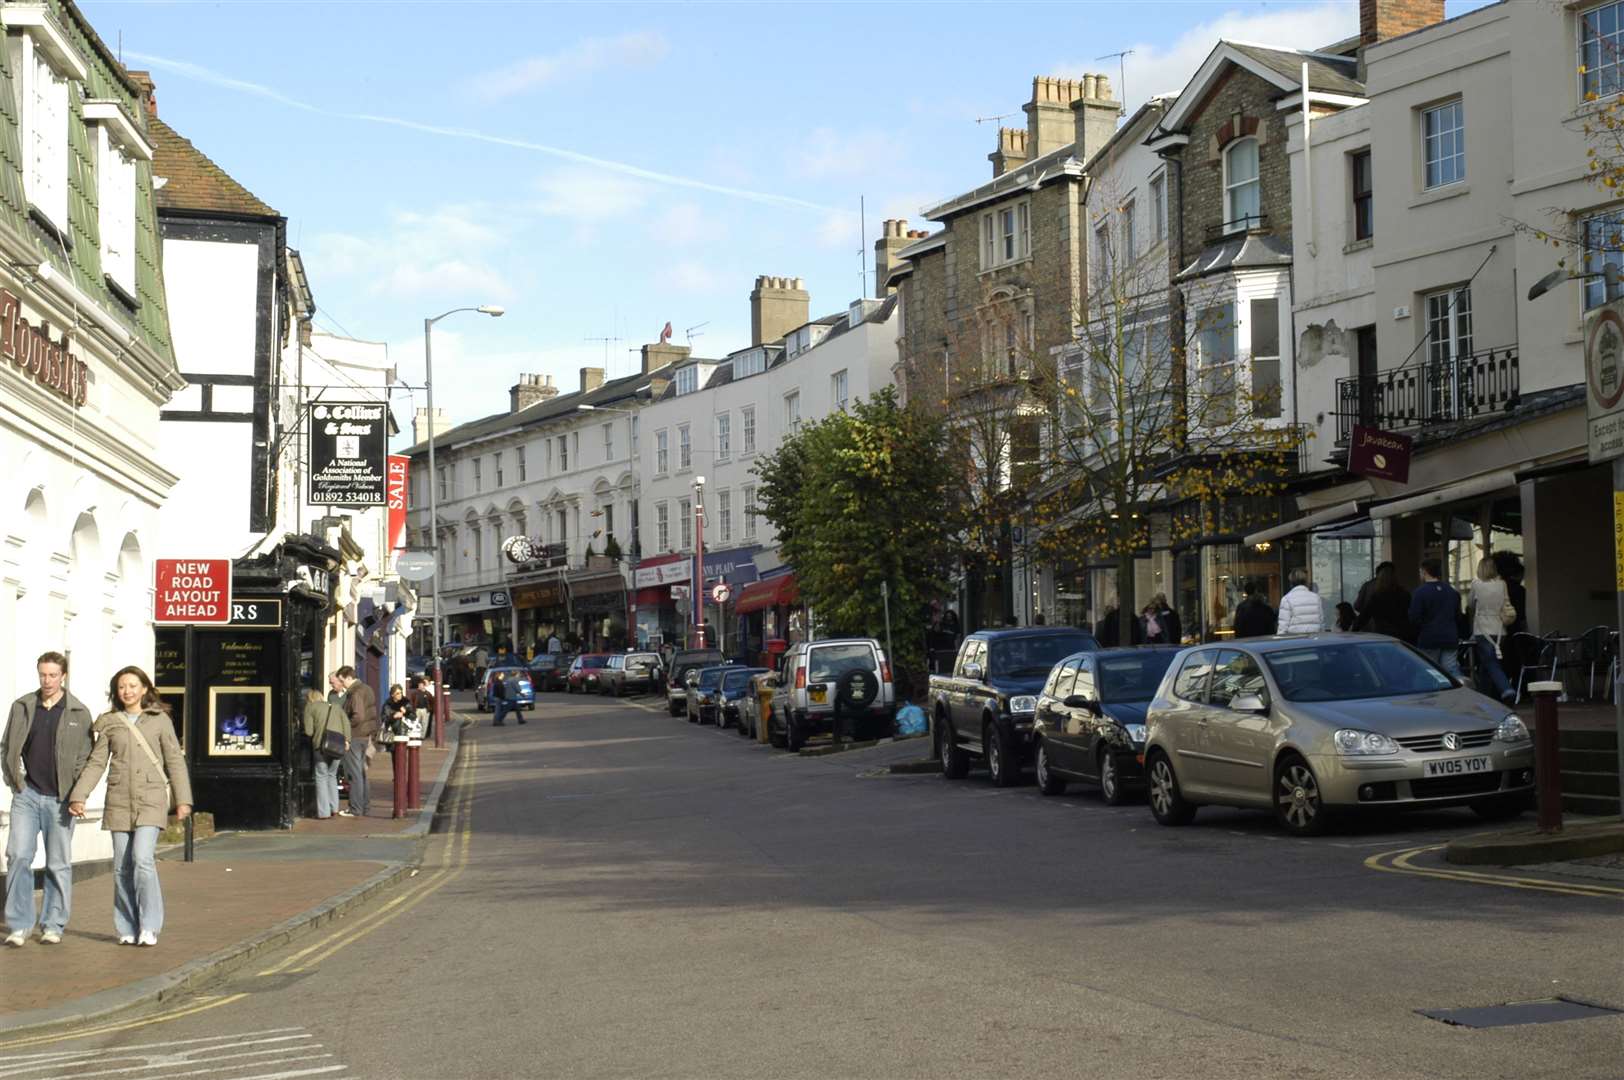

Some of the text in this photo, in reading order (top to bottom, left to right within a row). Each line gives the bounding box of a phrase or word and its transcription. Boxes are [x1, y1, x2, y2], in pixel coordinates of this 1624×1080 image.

[332, 405, 382, 420] Collins
[324, 422, 339, 435] &
[329, 459, 367, 467] A National
[363, 466, 373, 474] of
[313, 474, 382, 482] Goldsmiths Member
[389, 462, 405, 510] SALE
[313, 492, 381, 502] 01892 534018
[176, 563, 210, 574] NEW
[172, 577, 213, 588] ROAD
[165, 591, 220, 602] LAYOUT
[166, 605, 217, 616] AHEAD
[1429, 760, 1462, 775] WV05
